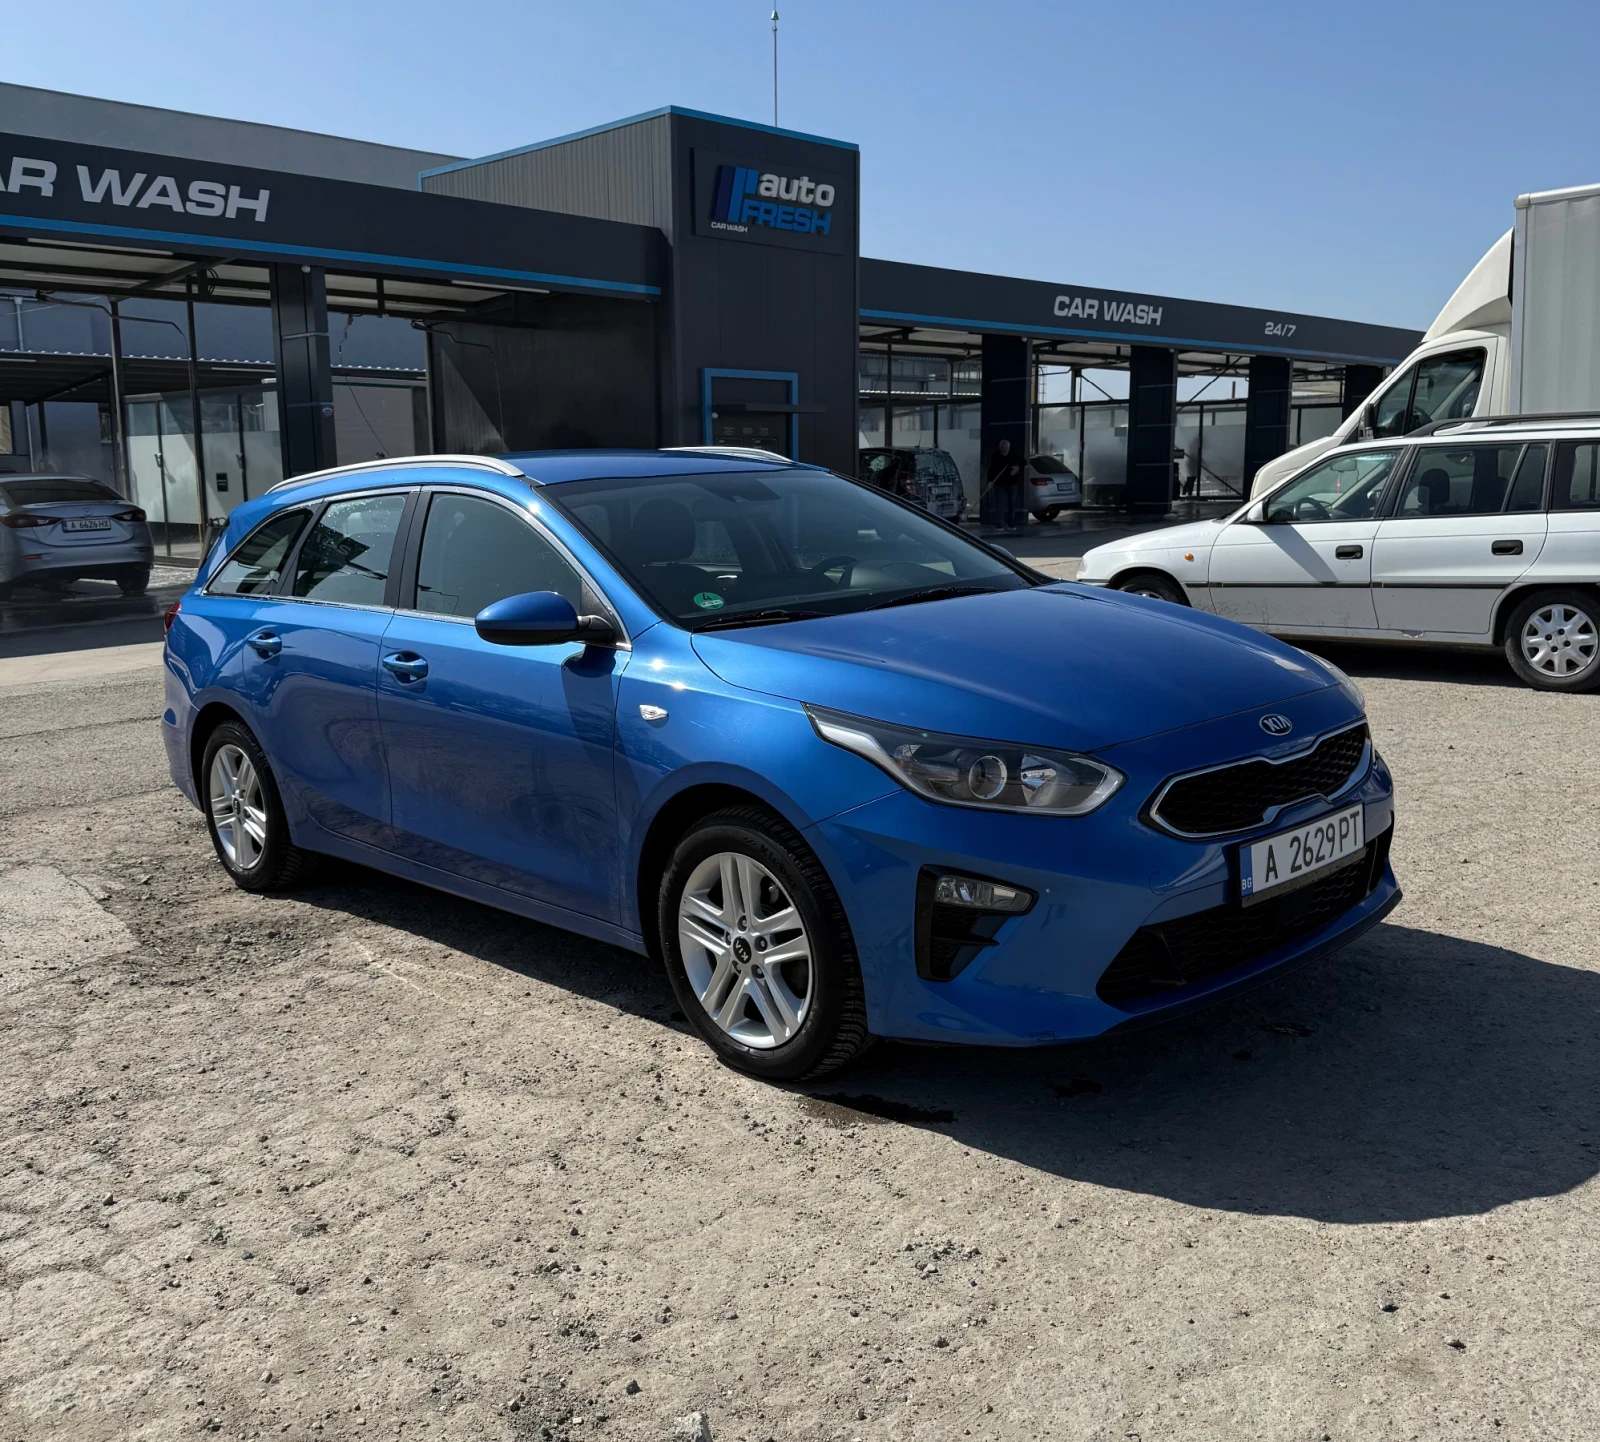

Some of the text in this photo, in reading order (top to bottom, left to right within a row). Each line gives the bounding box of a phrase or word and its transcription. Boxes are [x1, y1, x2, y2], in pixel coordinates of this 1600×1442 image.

[0, 156, 270, 223] R WASH
[758, 173, 835, 207] auto
[710, 221, 748, 233] CAR WASH
[741, 198, 832, 236] FRESH
[1053, 295, 1163, 326] CAR WASH
[1264, 321, 1296, 338] 24/7
[1262, 715, 1291, 732] KIA
[1265, 844, 1279, 883] A
[1241, 877, 1252, 891] BG
[735, 940, 749, 962] KIA
